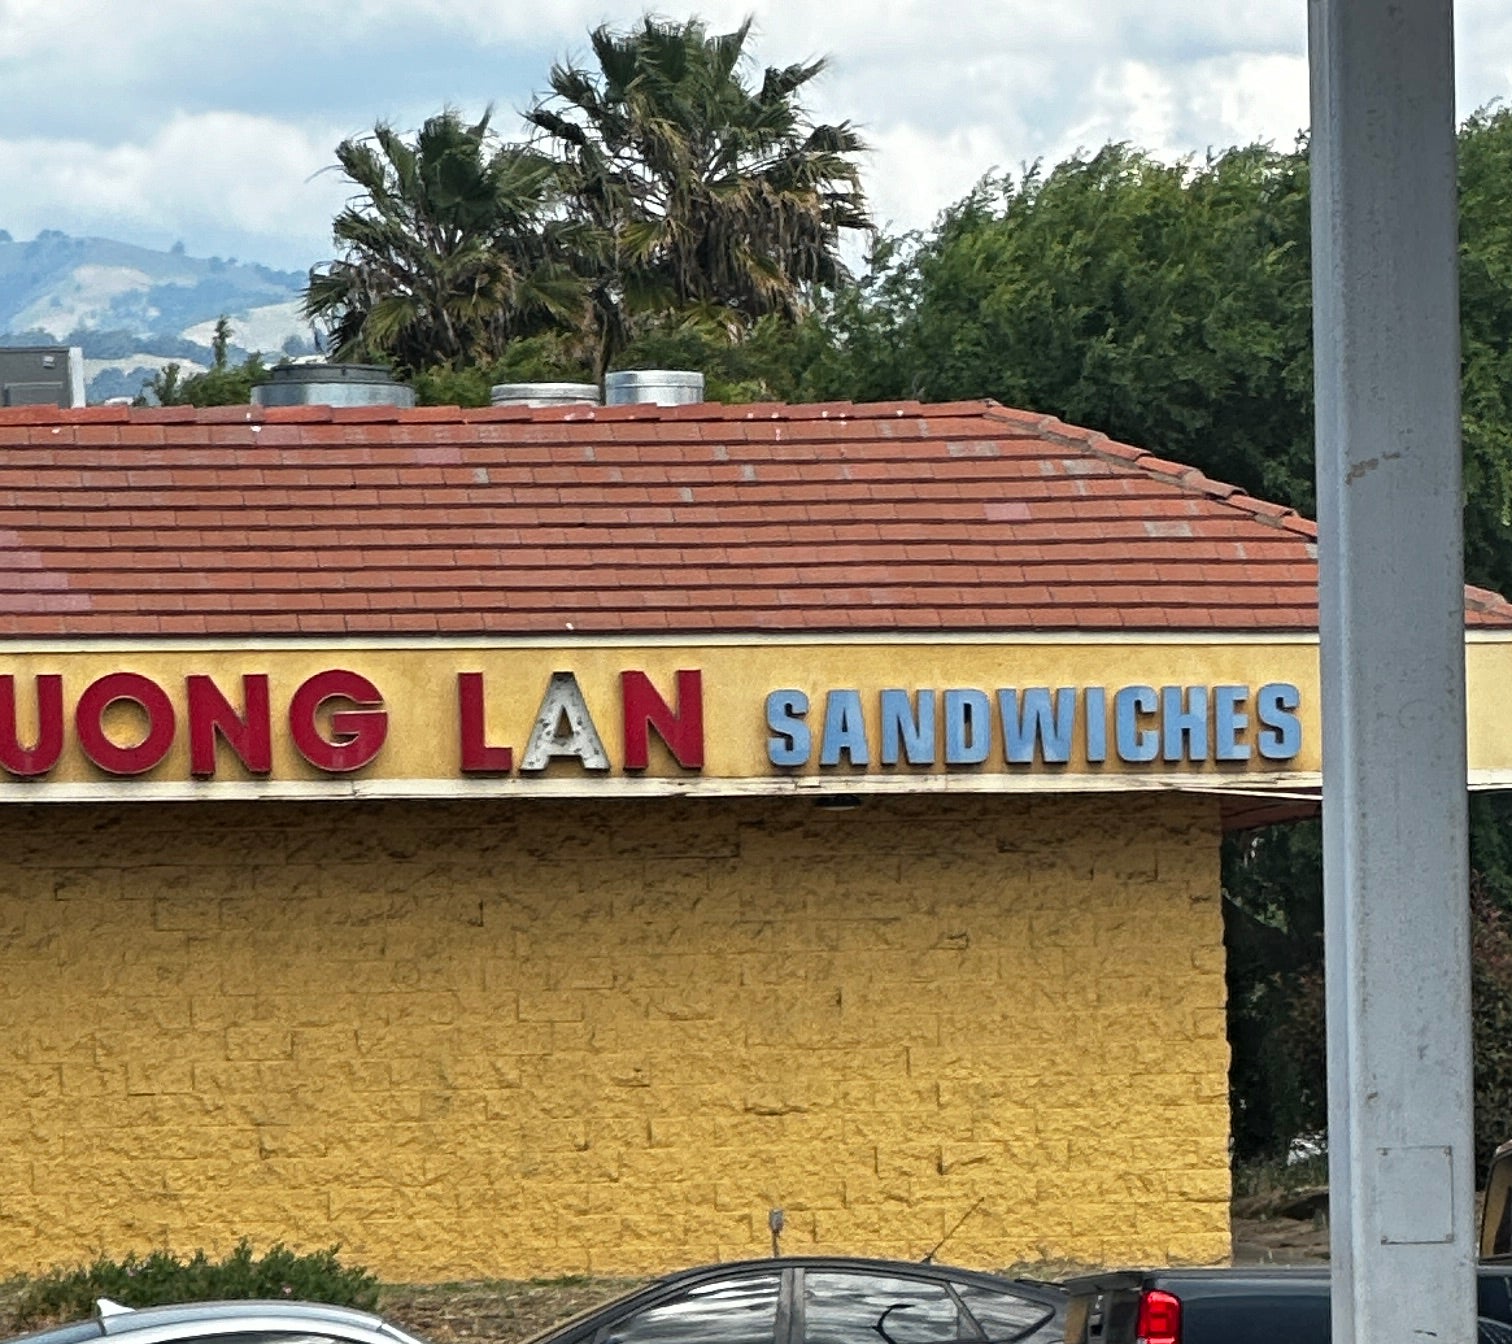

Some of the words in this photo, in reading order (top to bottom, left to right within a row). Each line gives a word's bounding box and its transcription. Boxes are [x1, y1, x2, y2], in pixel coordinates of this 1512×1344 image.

[0, 669, 388, 776] UONG
[458, 669, 704, 774] LAN
[766, 683, 1301, 766] SANDWICHES
